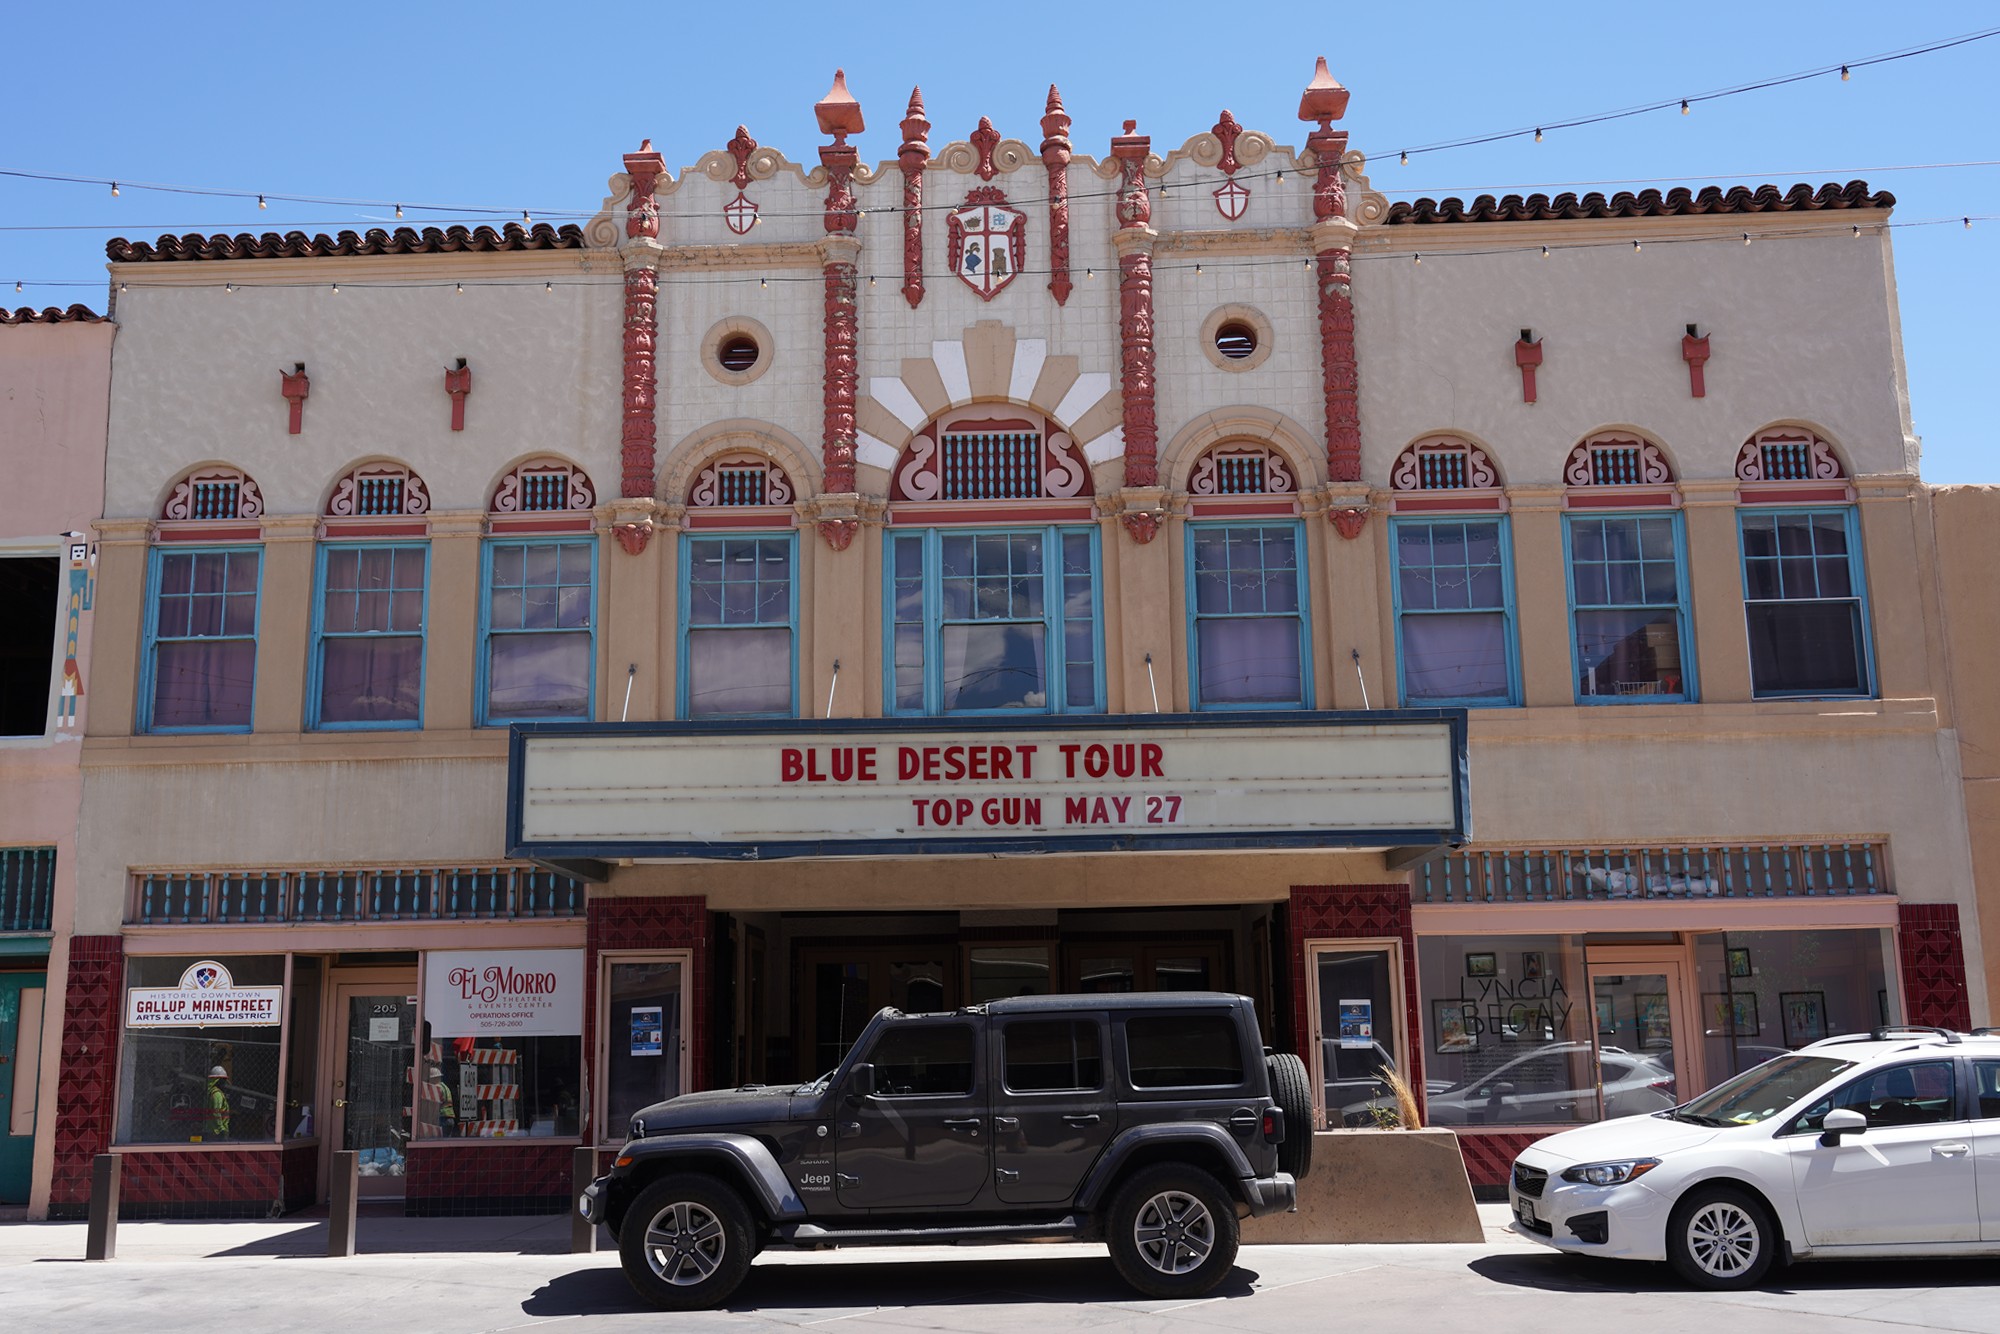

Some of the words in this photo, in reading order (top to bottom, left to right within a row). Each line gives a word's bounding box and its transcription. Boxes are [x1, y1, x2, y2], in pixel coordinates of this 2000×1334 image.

[781, 747, 877, 782] BLUE
[898, 746, 1038, 781] DESERT
[1059, 744, 1165, 778] TOUR
[912, 799, 974, 826] TOP
[981, 798, 1041, 826] GUN
[1065, 797, 1132, 824] MAY
[1146, 796, 1182, 823] 27
[1460, 976, 1568, 1002] LYNCIA
[136, 1001, 186, 1013] GALLUP
[192, 999, 273, 1012] MAINSTREET
[373, 1004, 397, 1013] 205
[1462, 1002, 1573, 1035] BEGAY
[800, 1173, 831, 1185] Jeep
